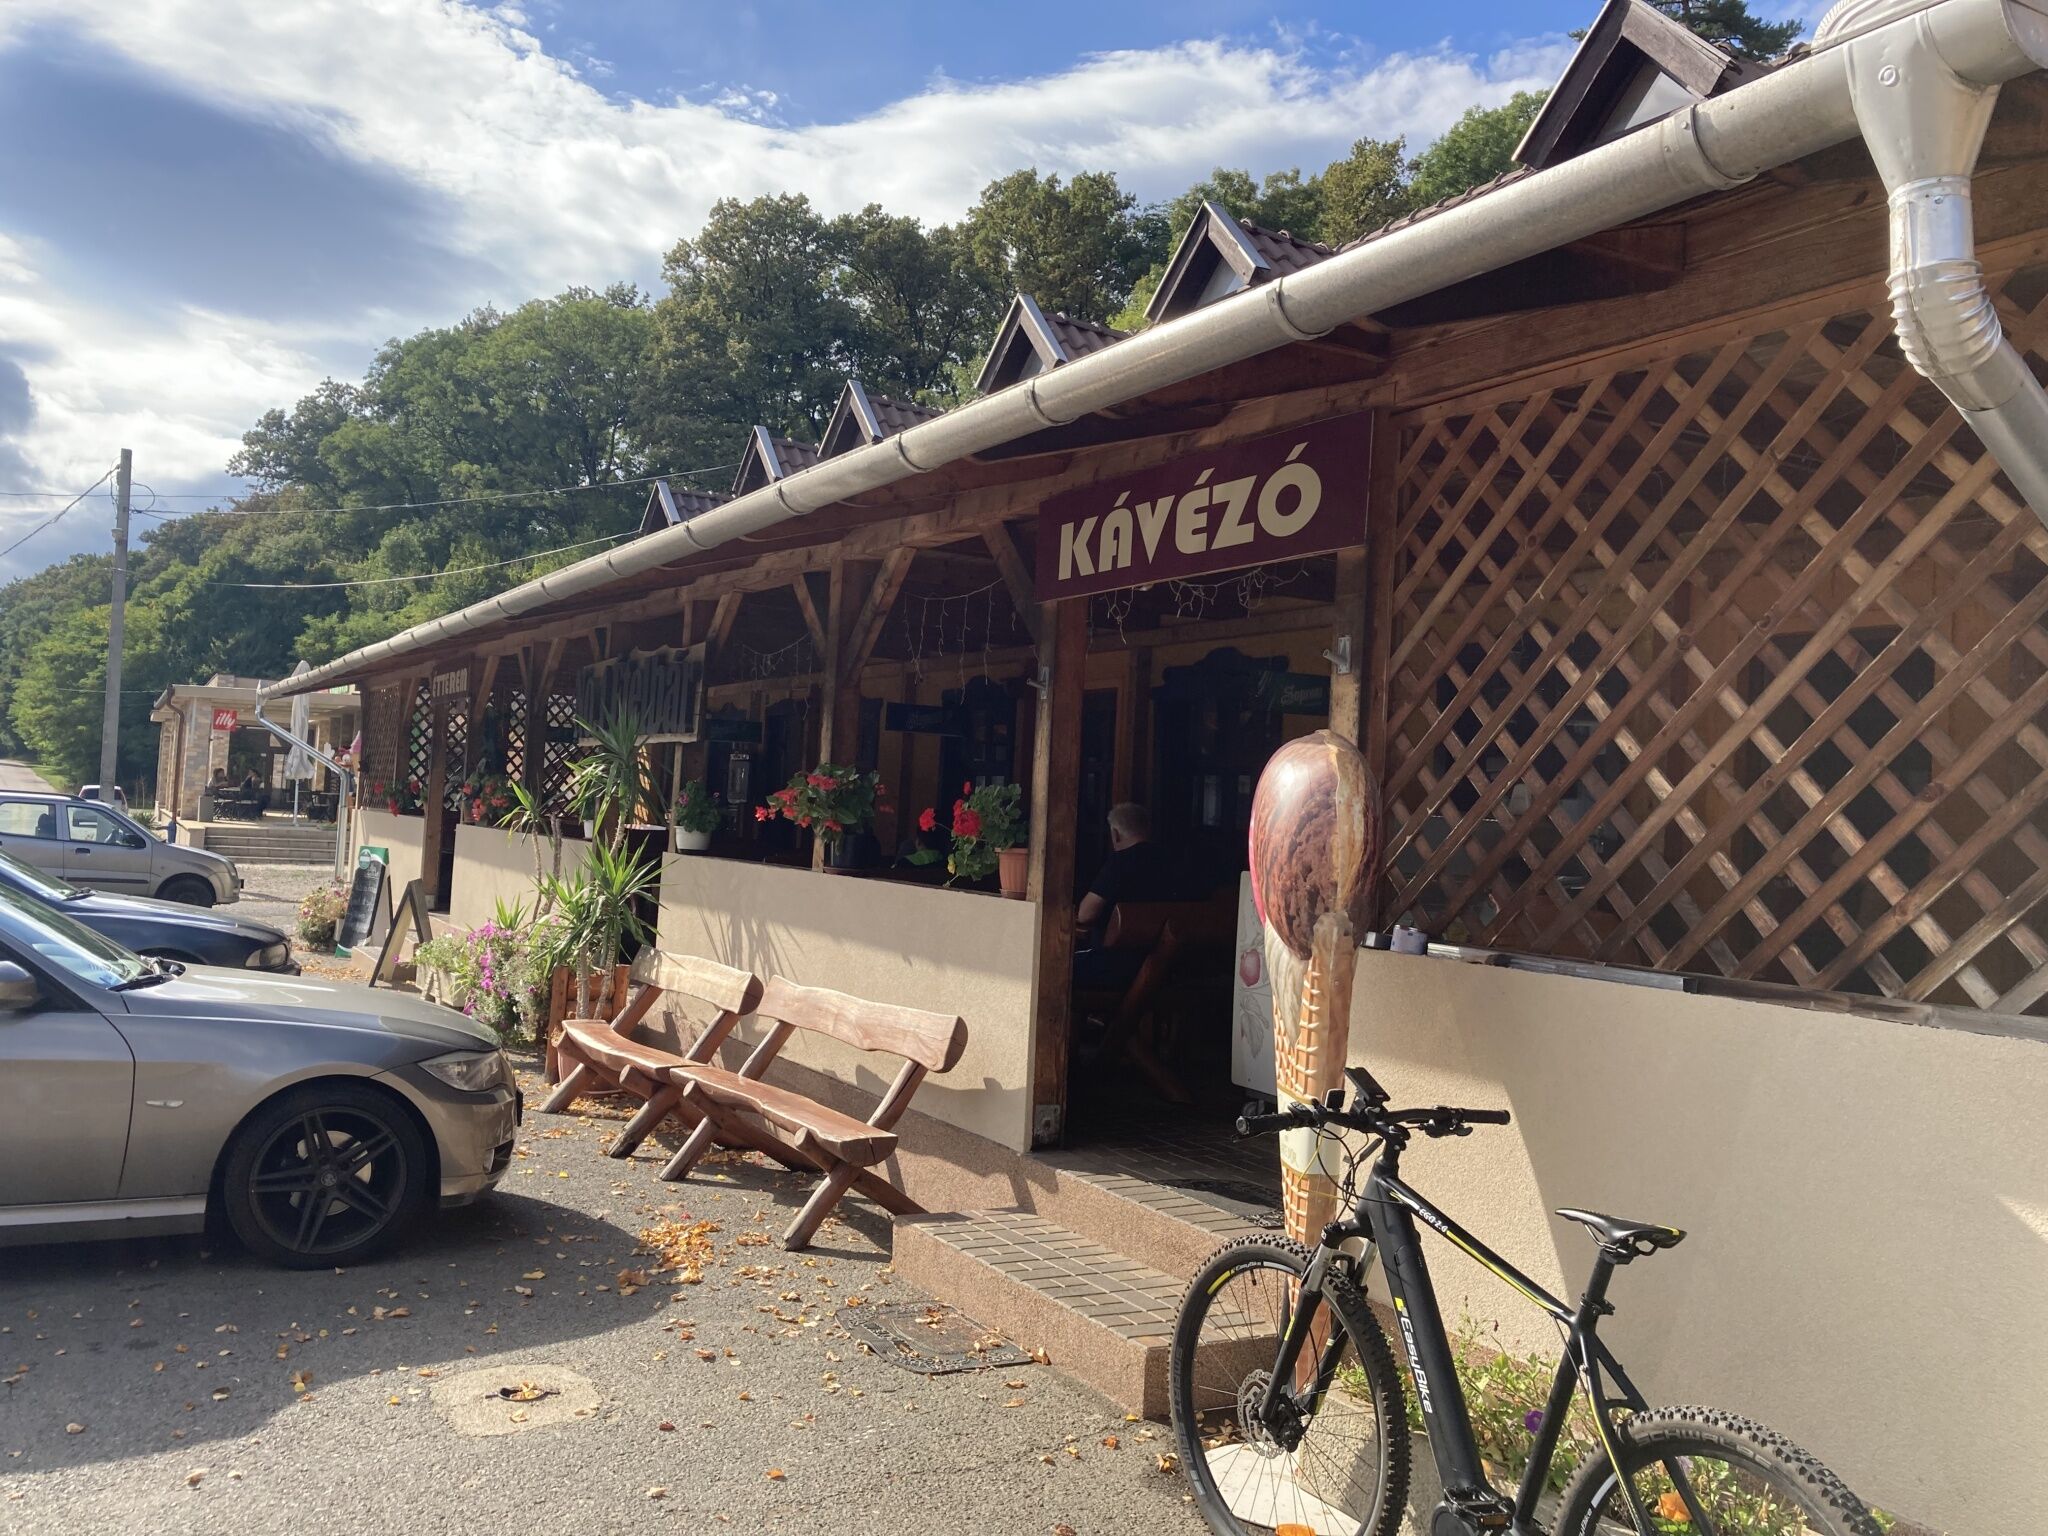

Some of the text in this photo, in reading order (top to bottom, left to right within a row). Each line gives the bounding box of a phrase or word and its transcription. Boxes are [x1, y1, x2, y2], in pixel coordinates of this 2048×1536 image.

[1058, 441, 1322, 581] KÁVÉZÓ
[215, 712, 236, 729] illy
[1418, 1208, 1436, 1224] EGO
[1400, 1316, 1433, 1414] EasyBike
[1173, 1344, 1194, 1464] SMART SAM
[1633, 1427, 1772, 1470] SCHWALBE
